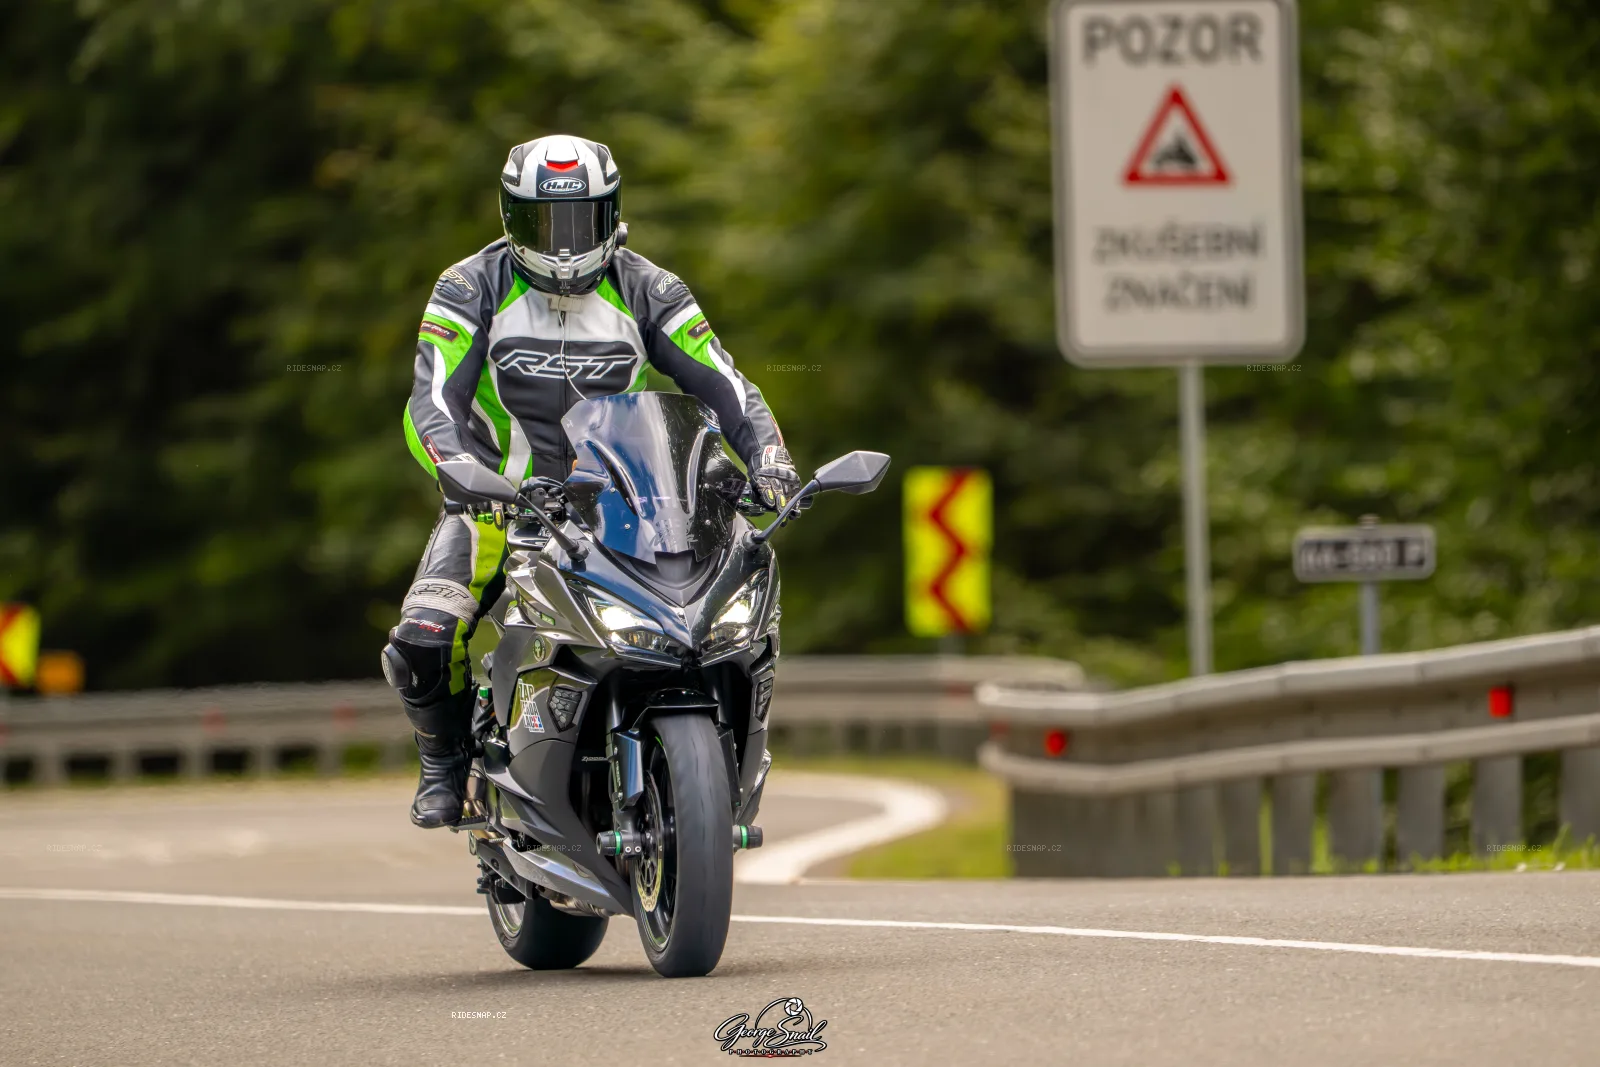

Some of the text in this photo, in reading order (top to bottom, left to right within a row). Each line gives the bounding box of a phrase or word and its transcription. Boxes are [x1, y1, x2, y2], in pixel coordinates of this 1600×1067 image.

[1081, 11, 1265, 66] POZOR
[546, 181, 580, 190] HJC
[496, 349, 638, 380] RST
[407, 583, 469, 600] RST
